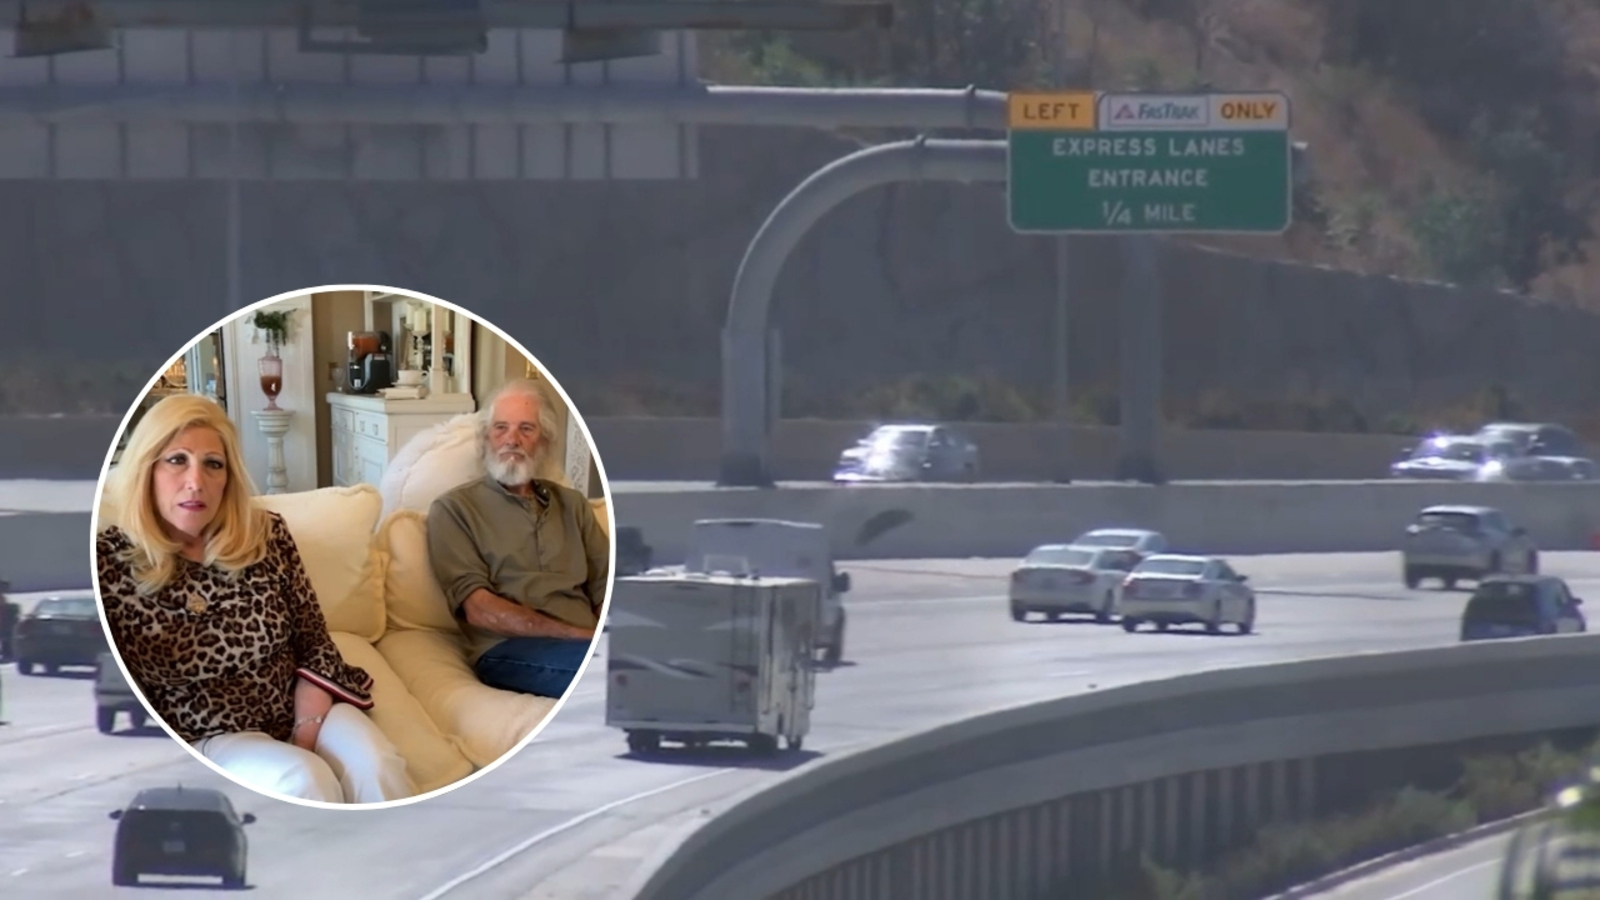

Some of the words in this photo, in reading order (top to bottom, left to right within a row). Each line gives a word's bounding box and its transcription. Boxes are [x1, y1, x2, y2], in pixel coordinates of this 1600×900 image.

[1023, 103, 1080, 120] LEFT
[1220, 103, 1277, 120] ONLY
[1052, 138, 1157, 157] EXPRESS
[1169, 138, 1246, 157] LANES
[1088, 169, 1209, 187] ENTRANCE
[1144, 204, 1197, 221] MILE
